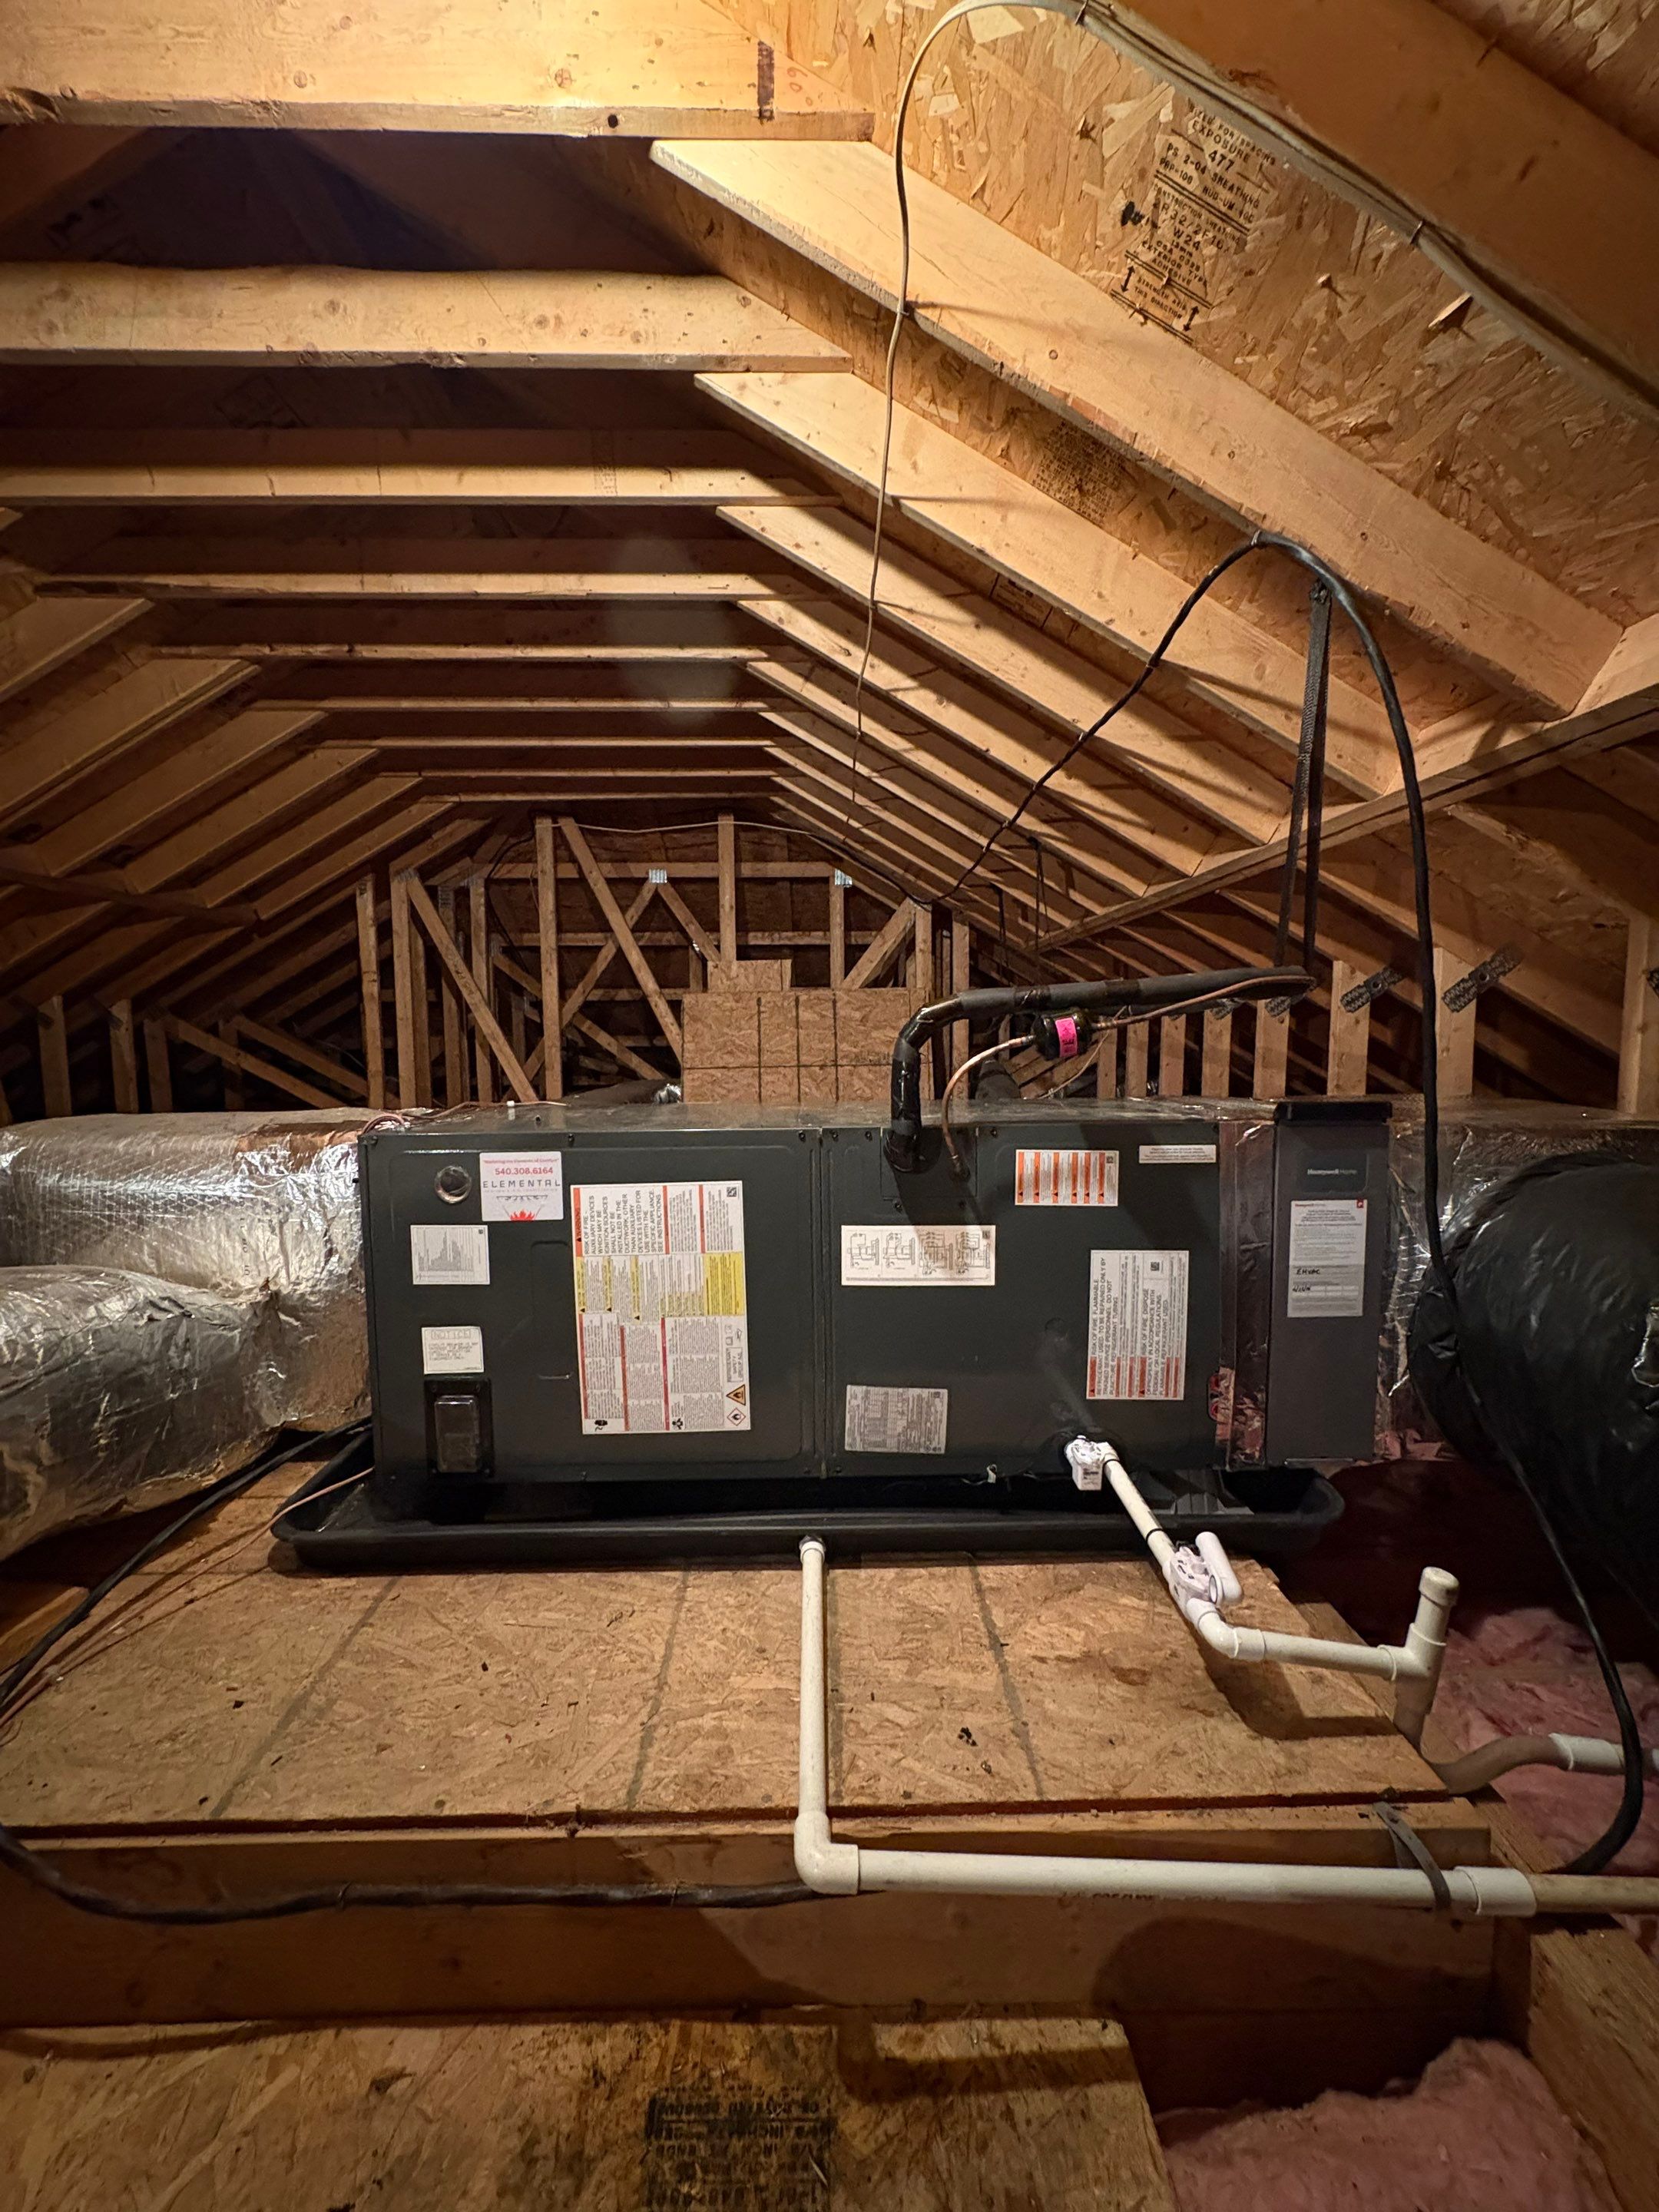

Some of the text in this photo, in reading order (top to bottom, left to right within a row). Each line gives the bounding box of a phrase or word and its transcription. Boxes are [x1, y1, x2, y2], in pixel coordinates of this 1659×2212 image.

[1191, 120, 1251, 164] EXPOSURE
[1206, 147, 1235, 172] 477
[1141, 240, 1182, 270] EXTERIOR
[495, 1167, 553, 1175] 540.308.6164
[483, 1180, 561, 1188] ELEMENTAL
